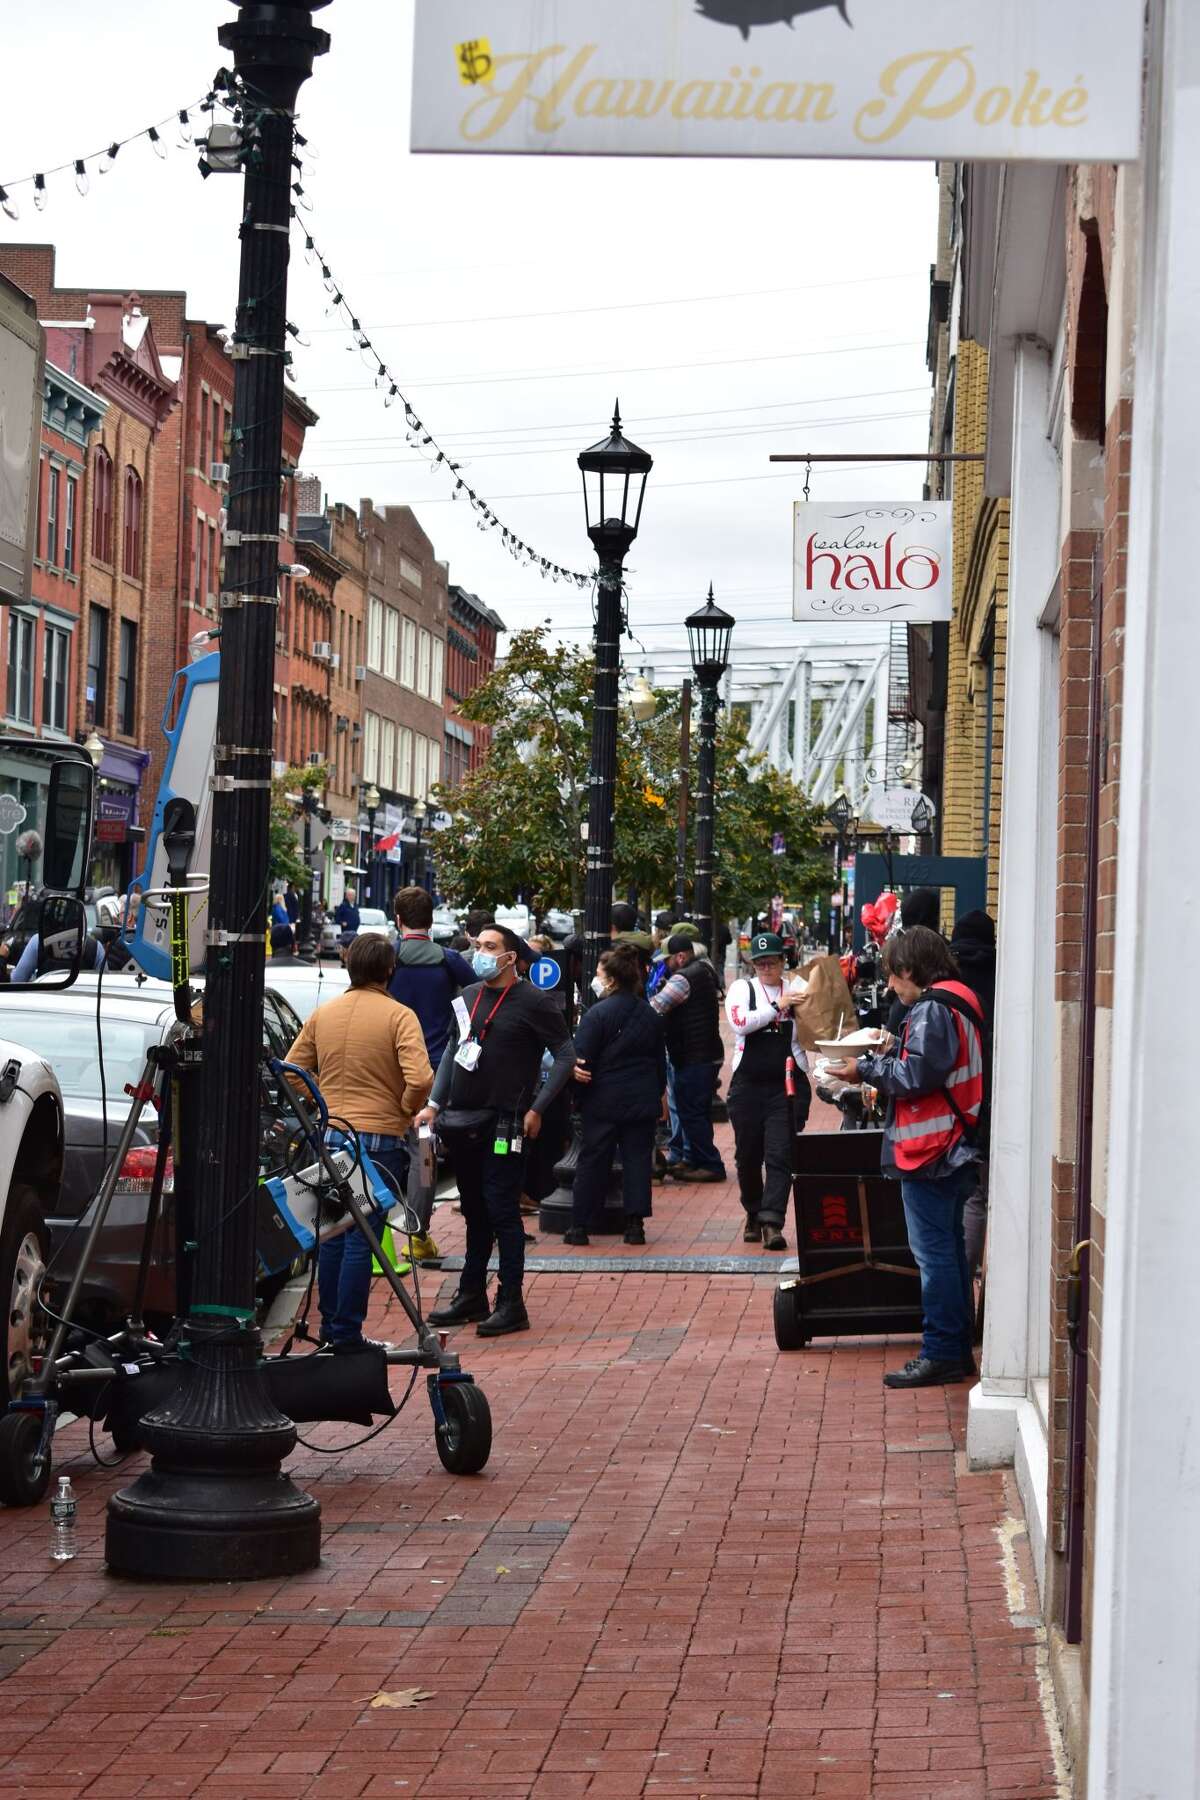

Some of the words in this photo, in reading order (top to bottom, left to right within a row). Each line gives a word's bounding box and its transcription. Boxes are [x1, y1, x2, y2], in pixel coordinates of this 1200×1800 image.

[459, 44, 837, 142] Hawaiian
[852, 45, 1089, 144] Poké
[814, 526, 883, 549] salon
[806, 532, 940, 590] halo
[539, 963, 553, 985] P
